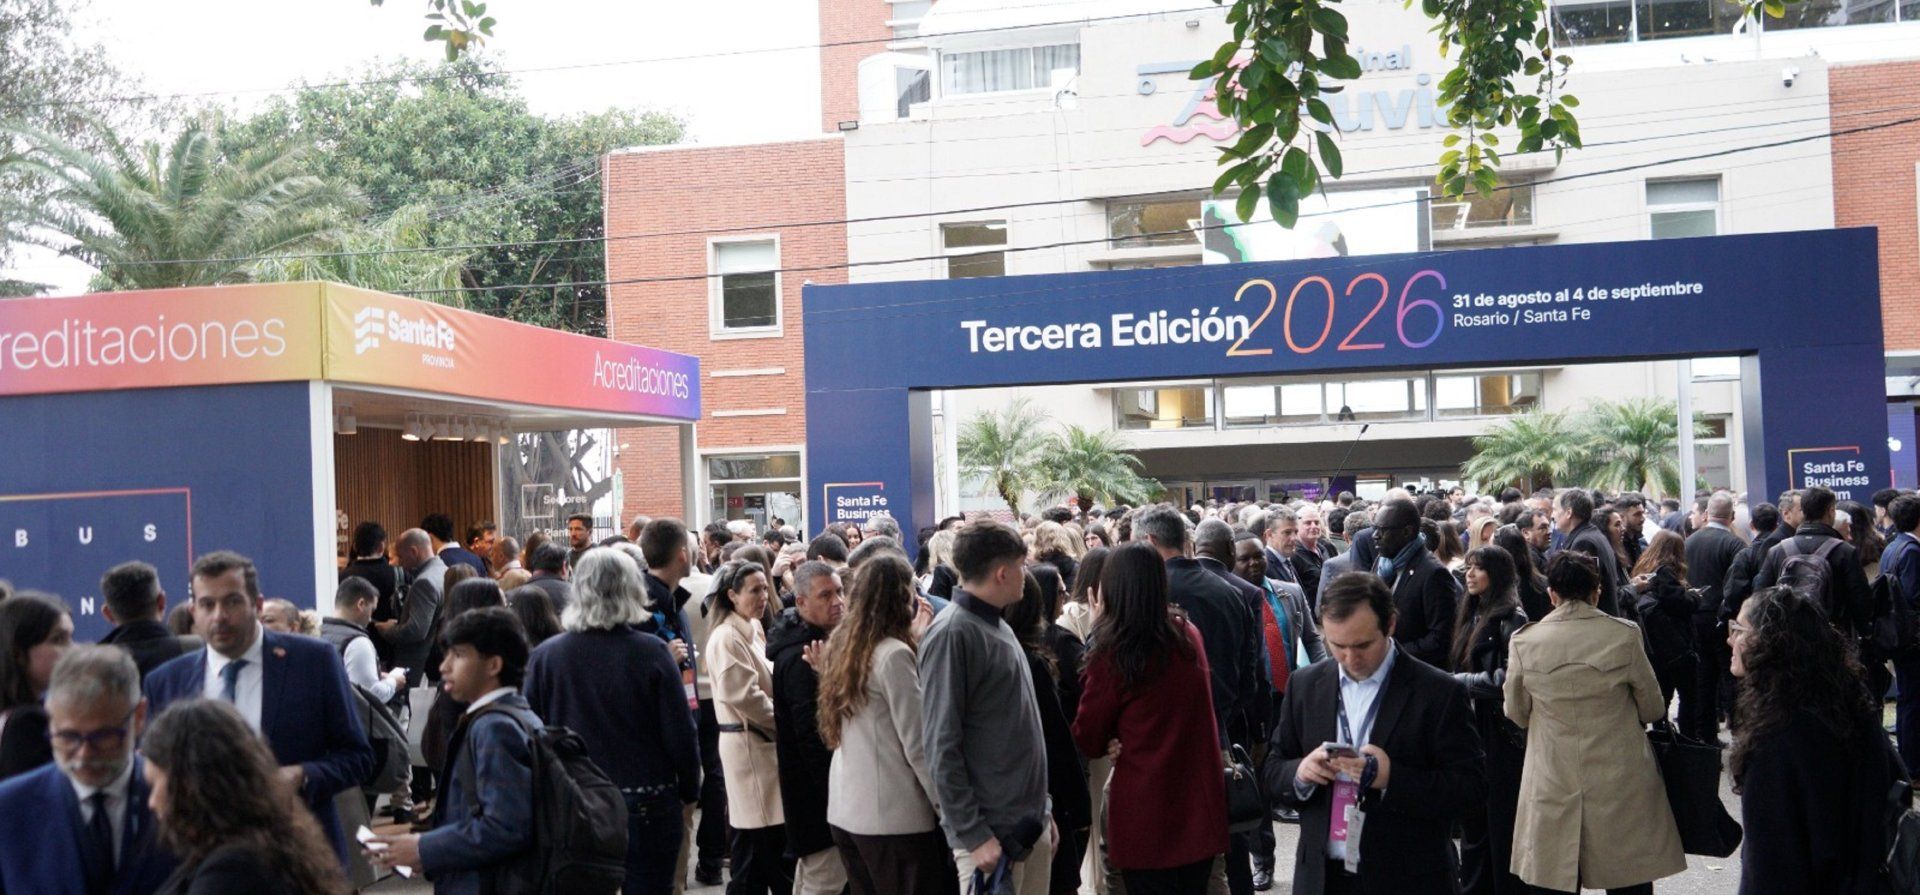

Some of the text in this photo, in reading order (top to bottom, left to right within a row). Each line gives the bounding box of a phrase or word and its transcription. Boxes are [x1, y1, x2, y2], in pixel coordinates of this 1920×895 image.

[1453, 281, 1703, 308] 31 de agosto al 4 de septiembre
[961, 270, 1447, 356] Tercera Edición 2026
[1453, 306, 1591, 327] Rosario / Santa Fe
[421, 353, 455, 369] PROVINCIA
[593, 351, 689, 399] Acreditaciones
[1804, 460, 1865, 474] Santa Fe
[1805, 475, 1869, 488] Business
[837, 495, 888, 507] Santa Fe
